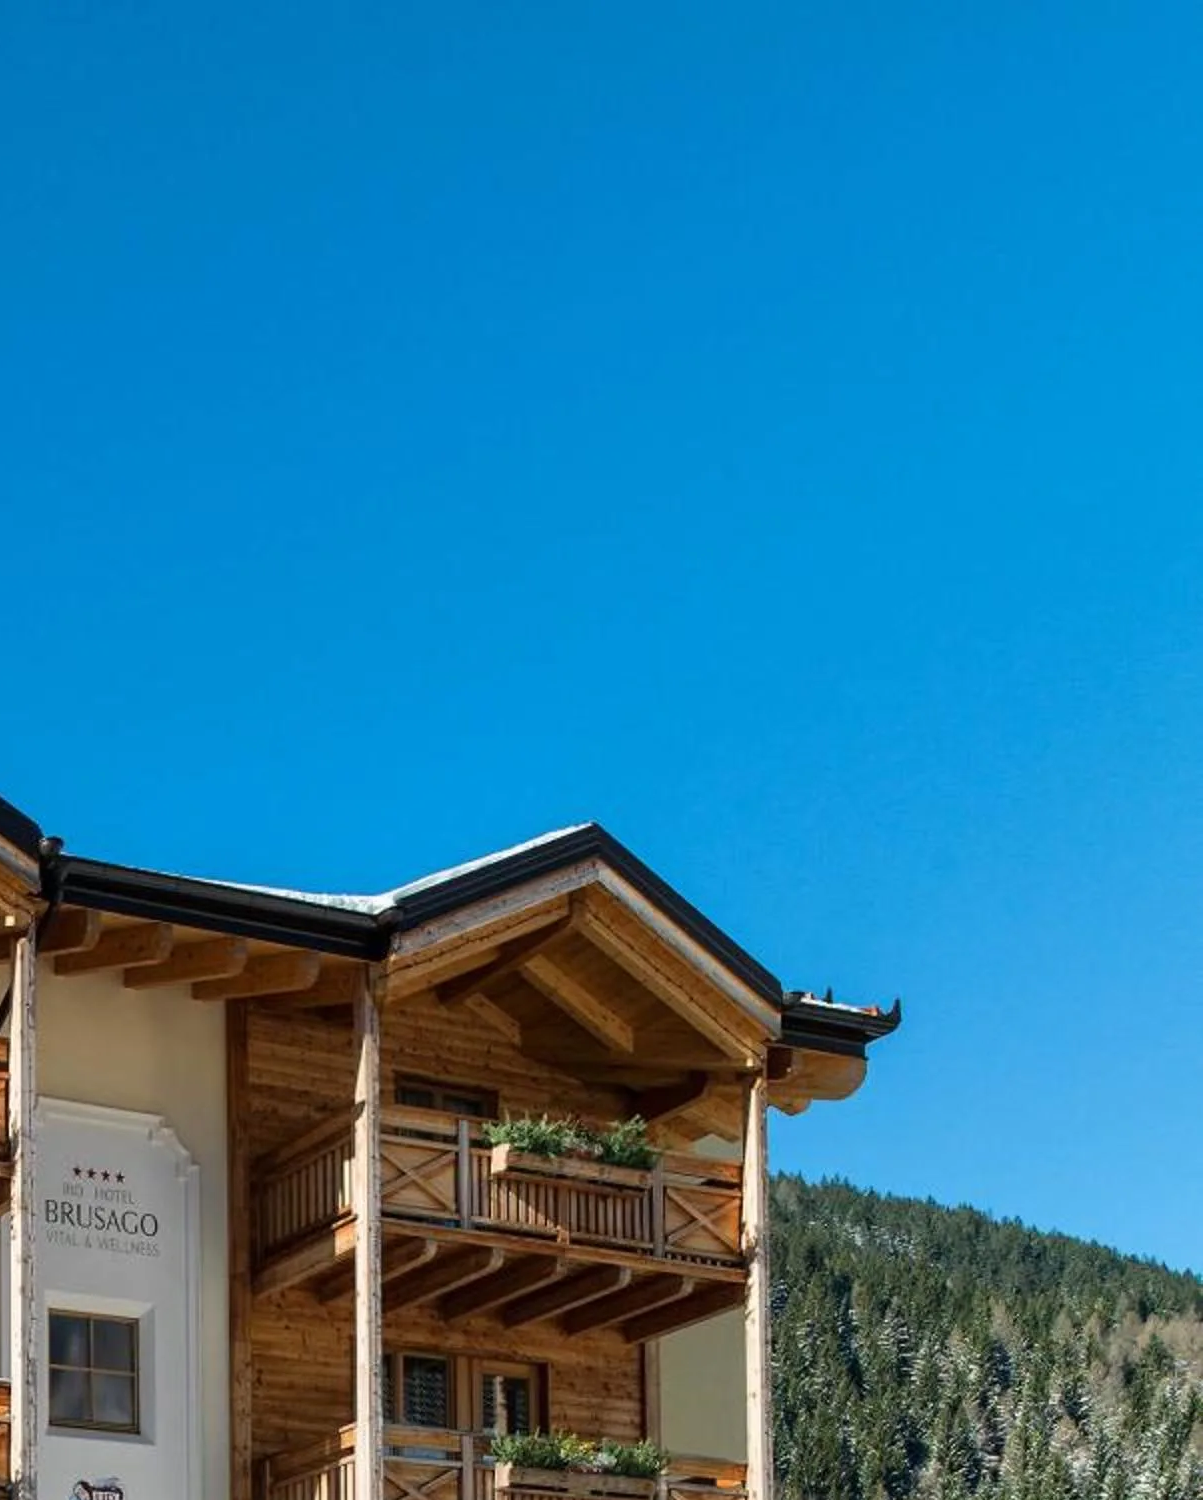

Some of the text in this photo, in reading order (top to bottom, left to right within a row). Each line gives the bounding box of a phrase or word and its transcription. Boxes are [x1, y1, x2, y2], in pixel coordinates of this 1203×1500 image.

[94, 1186, 137, 1205] HOTEL
[45, 1199, 159, 1237] BRUSAGO
[47, 1230, 78, 1247] VITAL
[96, 1237, 161, 1257] WELLNESS
